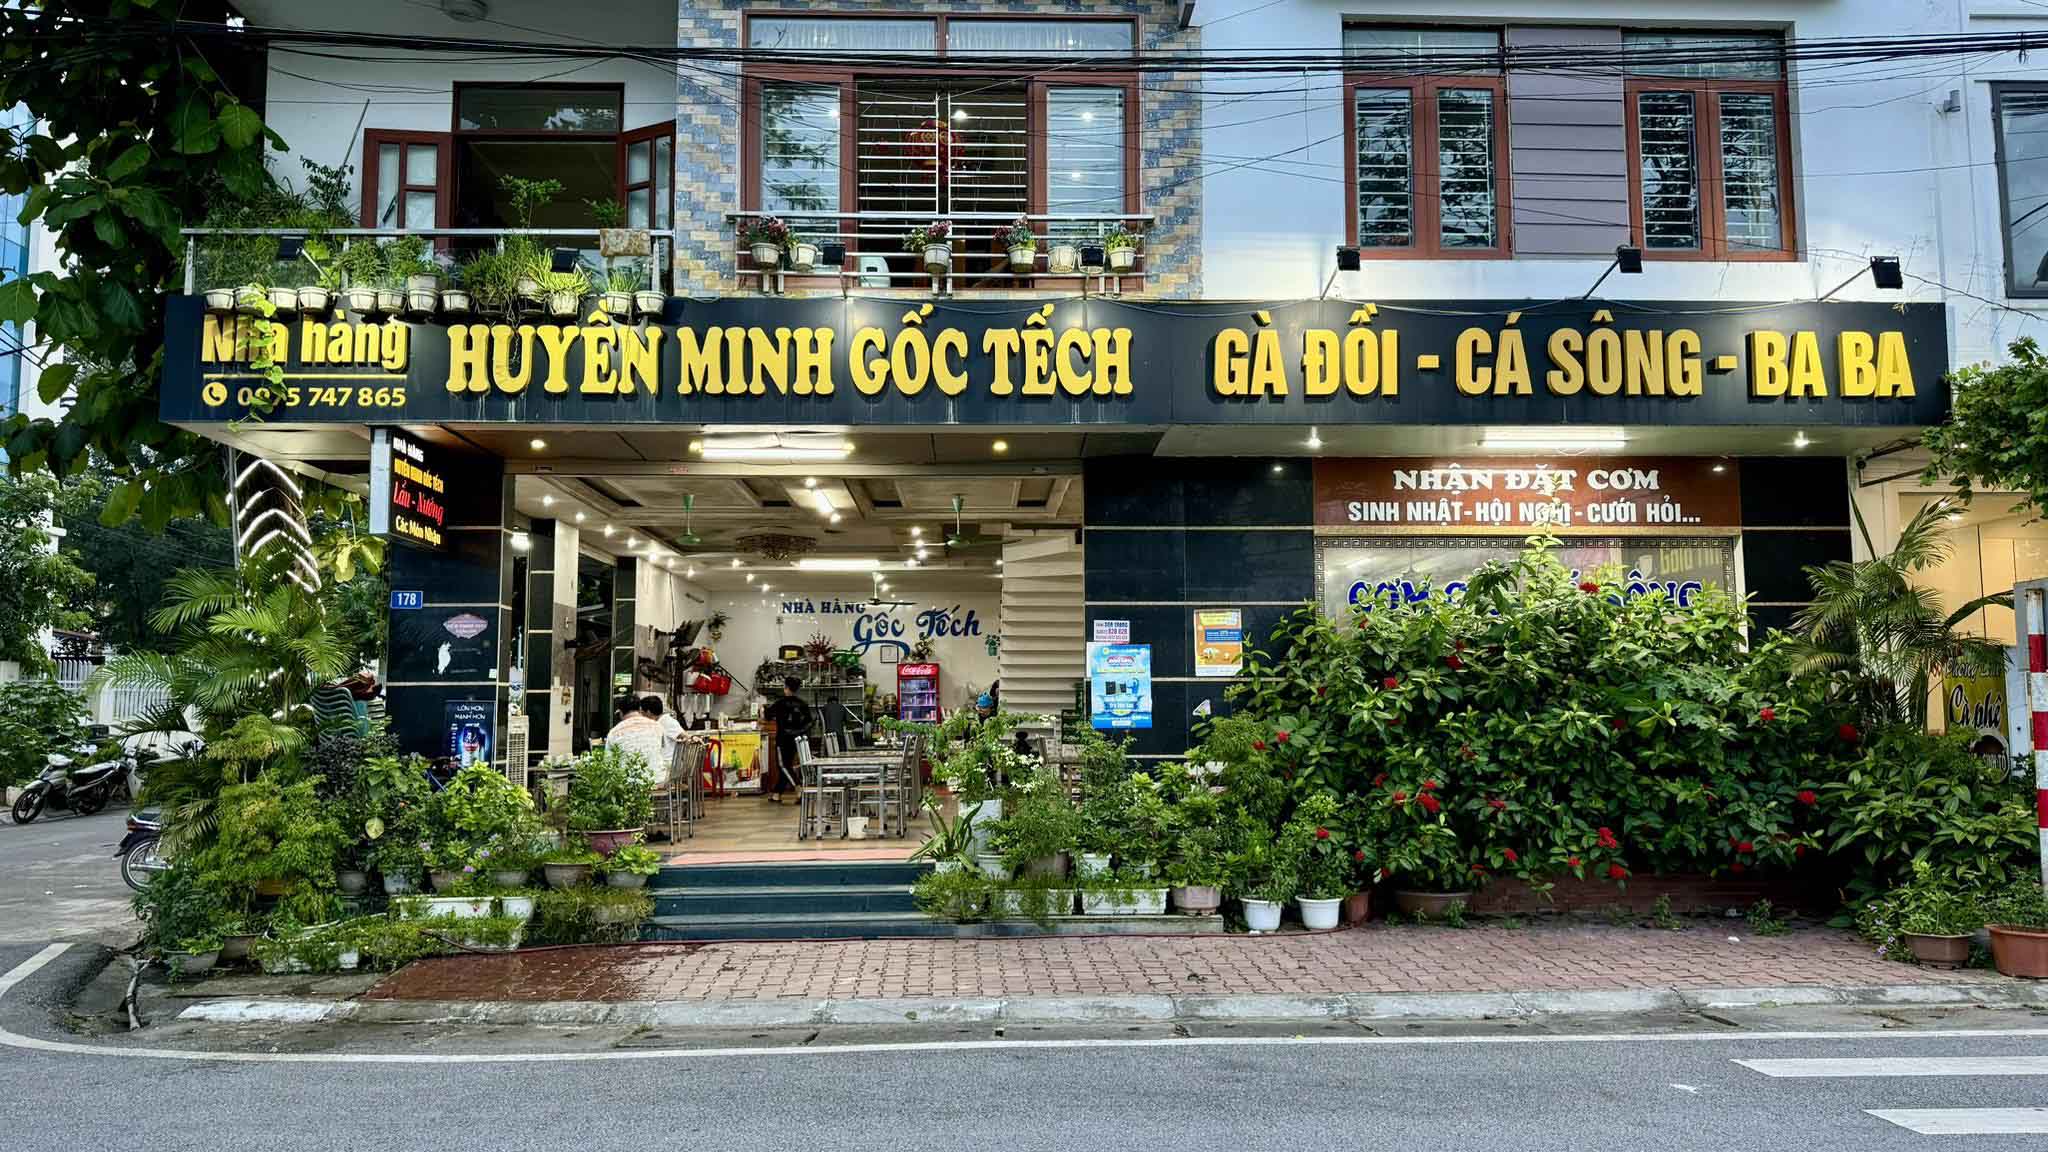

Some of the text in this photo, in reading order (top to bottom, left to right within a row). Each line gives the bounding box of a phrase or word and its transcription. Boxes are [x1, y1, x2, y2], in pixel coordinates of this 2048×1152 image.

[301, 309, 407, 371] hàng
[677, 326, 834, 395] MINH
[850, 303, 968, 395] GỐC
[983, 303, 1133, 395] TẾCH
[1213, 310, 1288, 396] GÀ
[1301, 303, 1398, 396] ĐỒI
[1456, 312, 1533, 396] CÁ
[1547, 309, 1704, 396] SÔNG
[1751, 330, 1829, 397] BA
[1838, 330, 1916, 397] BA
[308, 387, 352, 407] 747
[357, 387, 407, 407] 865
[1393, 463, 1494, 495] NHẬN
[1587, 467, 1661, 490] CƠM
[1348, 501, 1400, 522] SINH
[1587, 497, 1638, 523] CƯỚI
[397, 592, 417, 607] 178
[782, 598, 866, 614] NHÀ HÀNG
[851, 603, 982, 656] Gốc Tếch
